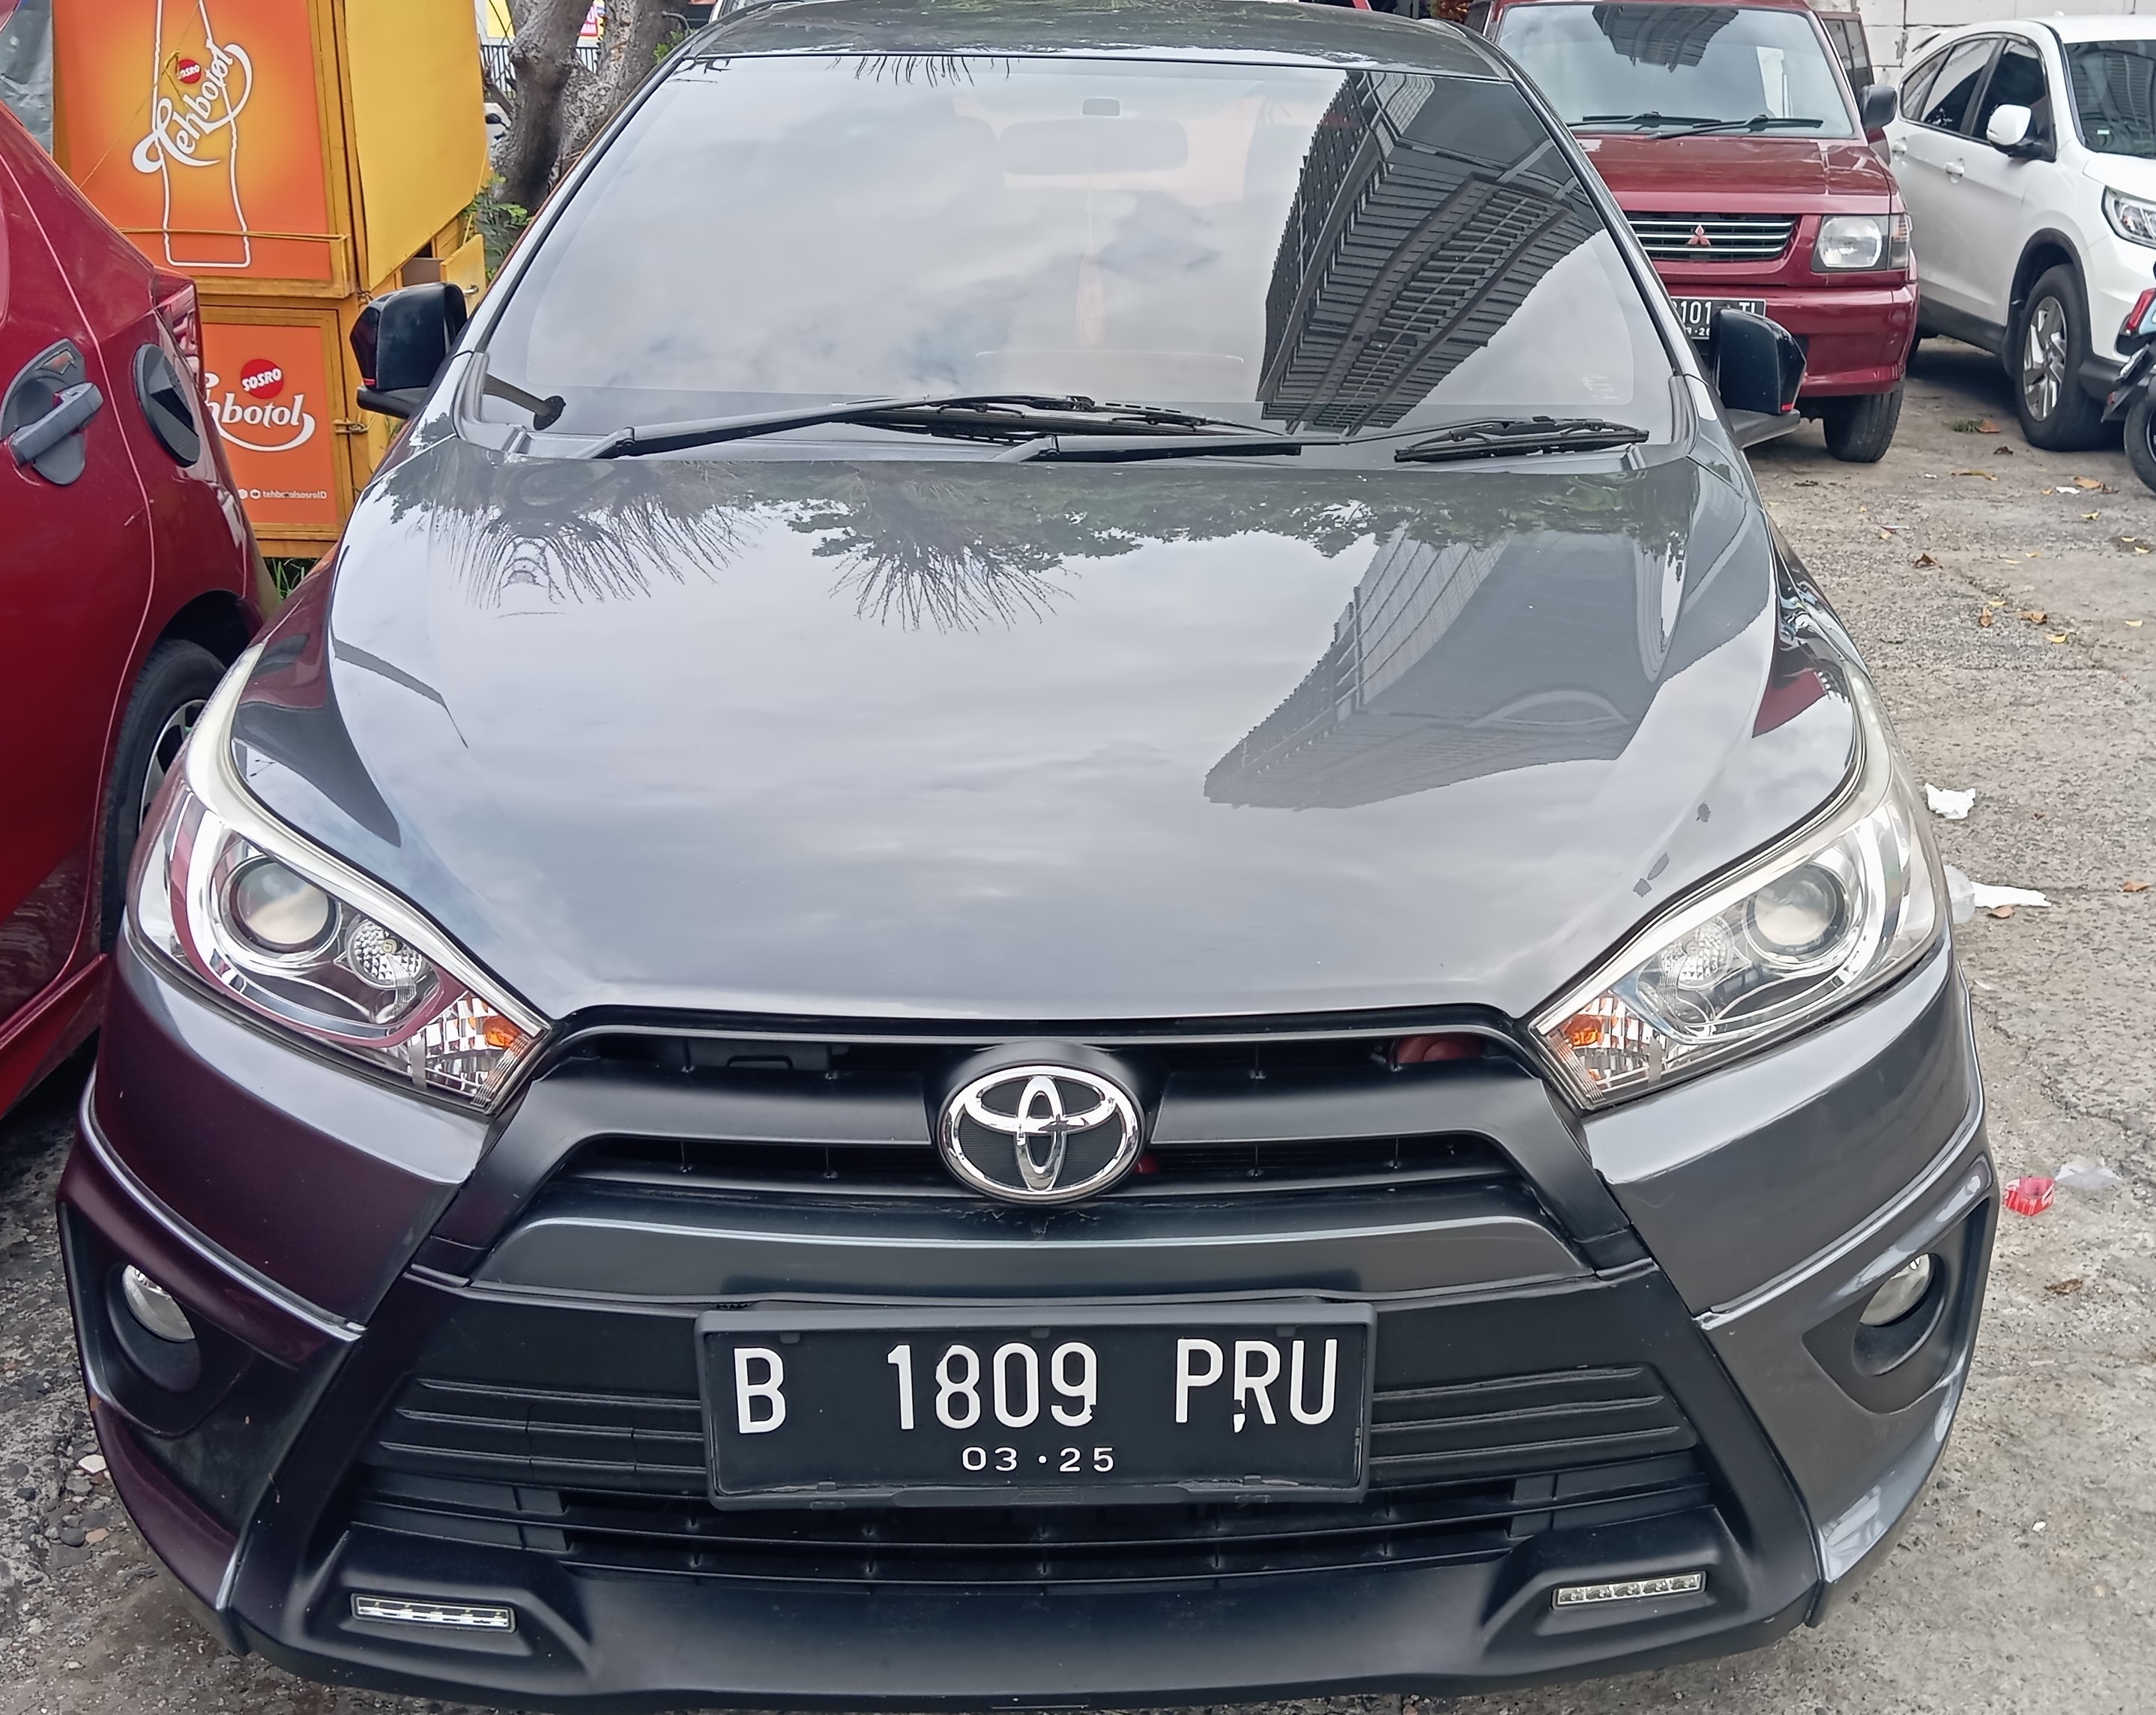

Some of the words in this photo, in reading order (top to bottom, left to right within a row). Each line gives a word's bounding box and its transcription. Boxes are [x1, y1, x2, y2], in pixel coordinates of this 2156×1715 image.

[132, 39, 253, 173] Tehbotol
[1672, 301, 1712, 325] 101
[242, 368, 282, 392] SOSRO
[734, 1347, 785, 1433] B
[887, 1342, 1098, 1430] 1809
[1176, 1339, 1338, 1432] PRU
